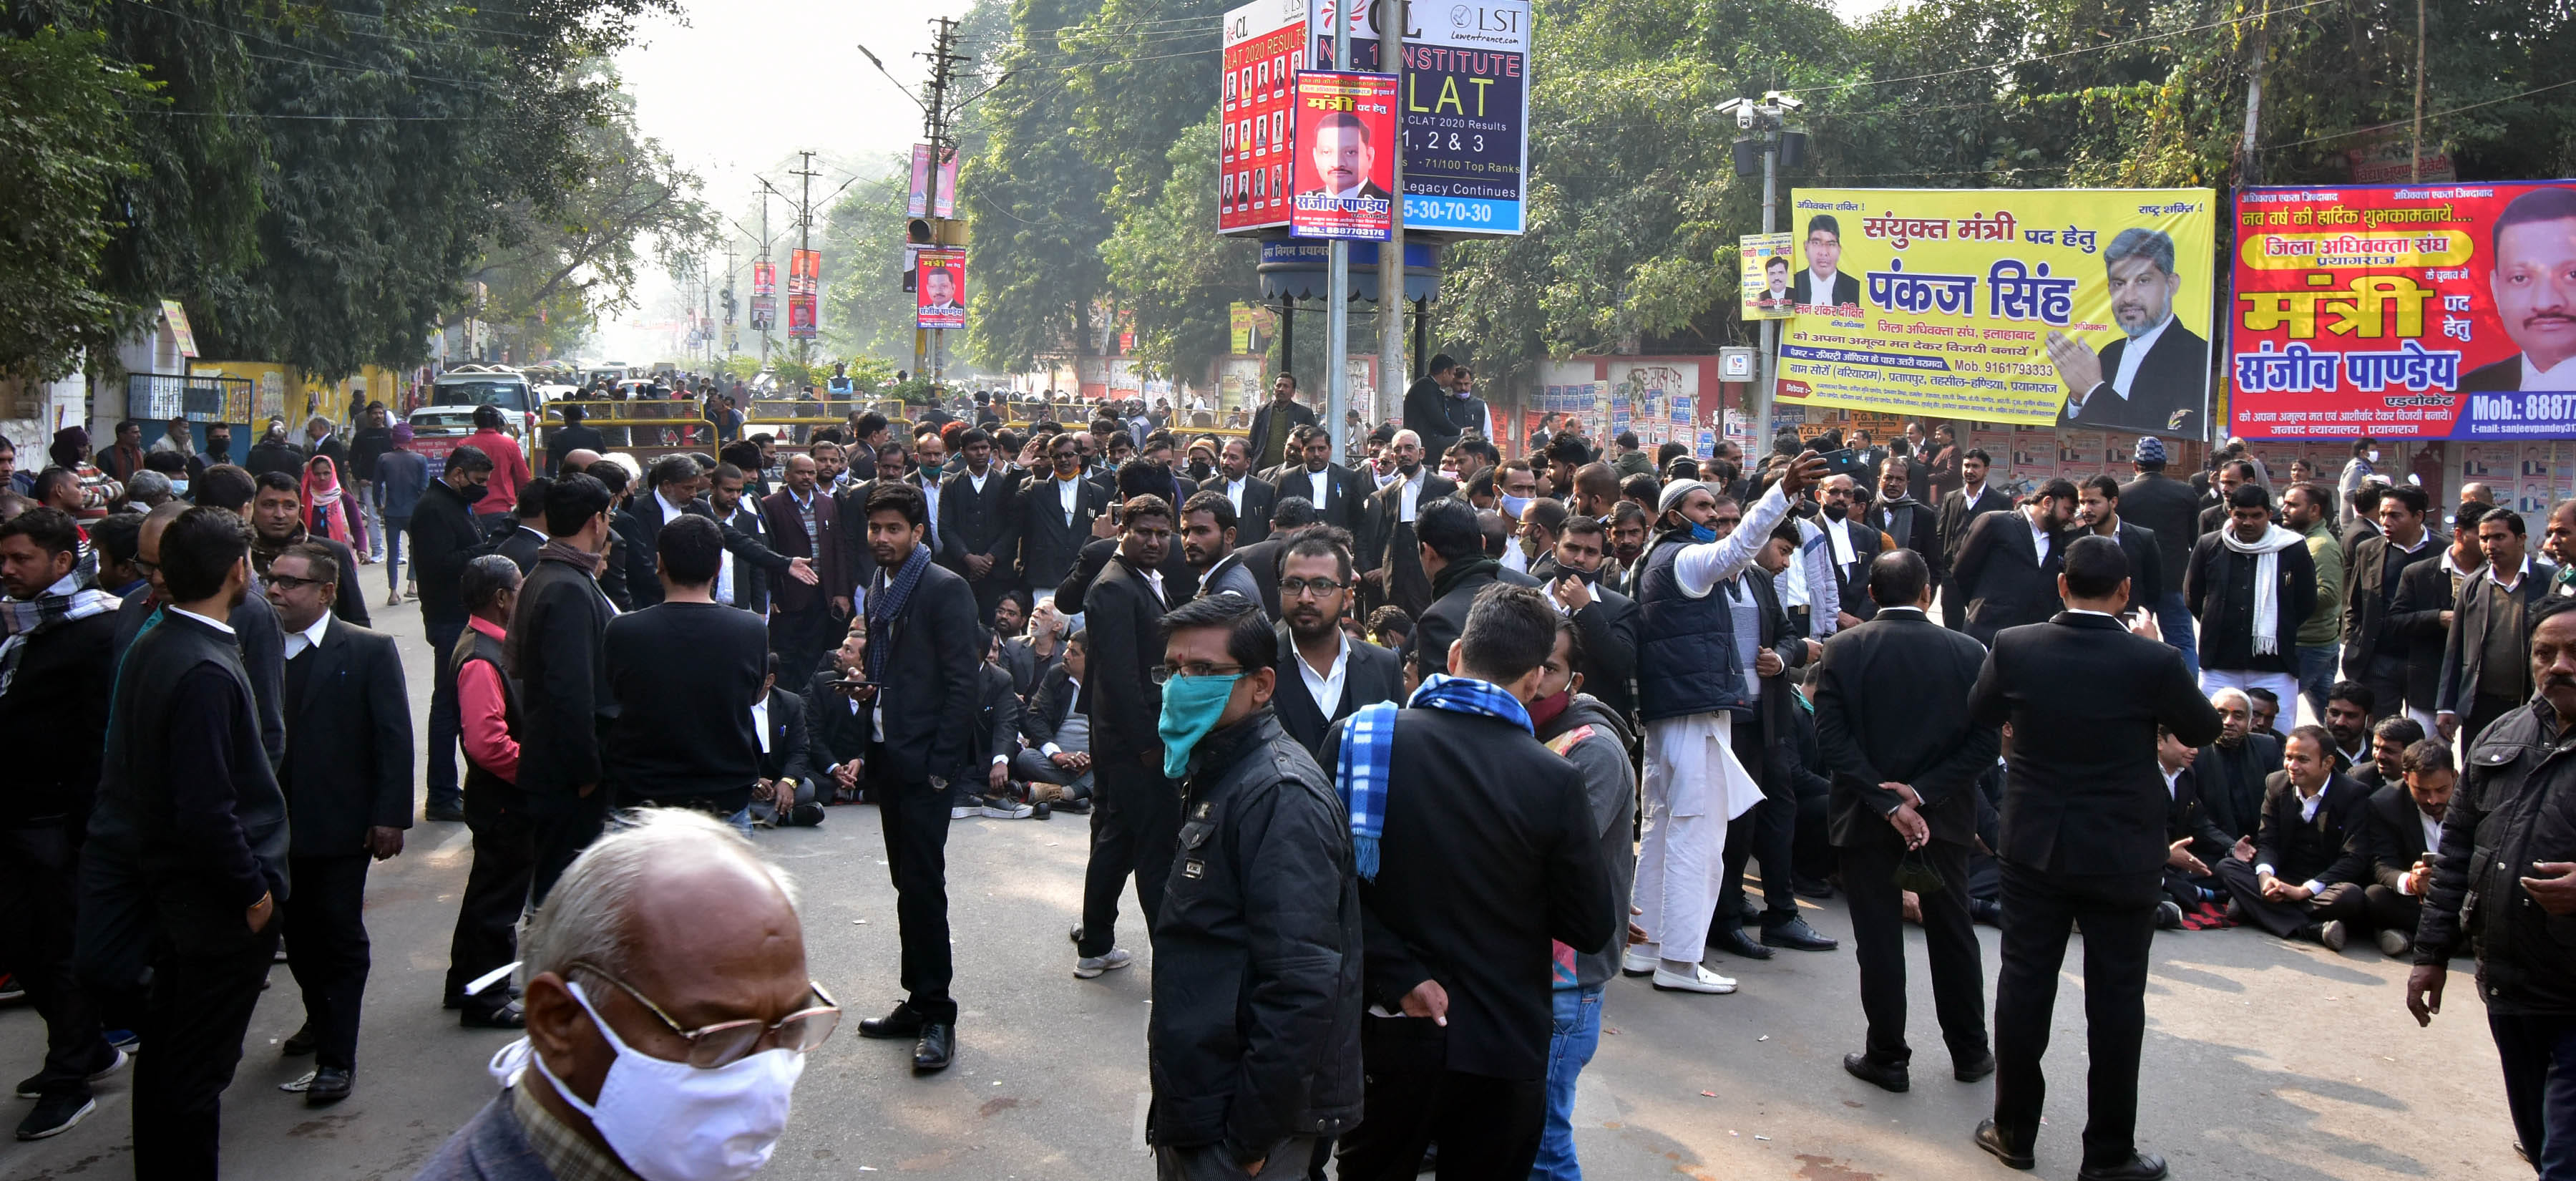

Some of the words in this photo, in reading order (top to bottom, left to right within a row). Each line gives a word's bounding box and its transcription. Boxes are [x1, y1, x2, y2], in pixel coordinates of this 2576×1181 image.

[1236, 16, 1248, 39] CL
[1479, 8, 1522, 33] LST
[1451, 31, 1518, 44] Lawentrance.com
[1224, 49, 1243, 71] CLAT
[1245, 42, 1264, 64] 2020
[1267, 26, 1307, 56] RESULTS
[1319, 38, 1359, 64] N.
[1370, 43, 1378, 65] 1
[1402, 46, 1520, 77] NSTITUTE
[1409, 72, 1494, 117] LAT
[1307, 94, 1356, 112] मंत्री
[1372, 103, 1387, 114] हेतु
[1408, 115, 1435, 126] CLAT
[1440, 117, 1465, 128] 2020
[1468, 120, 1506, 131] Results
[1428, 132, 1439, 150] 2
[1448, 132, 1461, 151] &
[1473, 135, 1483, 152] 3
[1425, 159, 1460, 170] 71/100
[1465, 161, 1484, 172] Top
[1488, 162, 1521, 174] Ranks
[1402, 180, 1448, 196] Legacy
[1453, 183, 1520, 198] Continues.
[2242, 193, 2276, 203] अधिवक्ता
[2279, 194, 2299, 203] एकता
[2302, 192, 2338, 202] जिन्दाबाद
[2394, 189, 2429, 200] अधिवक्ता
[2431, 190, 2454, 198] एकता
[2456, 188, 2494, 198] जिन्दाबाद
[1296, 191, 1339, 212] संजीव
[1342, 195, 1389, 214] पाण्डेय
[1404, 200, 1491, 223] 5-30-70-30
[1796, 200, 1833, 210] अधिवक्ता
[1835, 200, 1858, 210] शक्ति
[2163, 202, 2194, 214] शक्ति
[2242, 212, 2265, 226] नव
[2268, 206, 2290, 225] वर्ष
[2293, 206, 2313, 225] की
[2317, 204, 2360, 226] हार्दिक
[1863, 210, 1951, 250] संयुक्त
[1958, 210, 2016, 242] मंत्री
[2024, 229, 2056, 245] पद
[2062, 225, 2097, 254] हेतु
[1275, 244, 1296, 256] निगम
[1299, 246, 1330, 256] प्रयागर
[2265, 235, 2316, 256] जिला
[2321, 234, 2411, 255] अधिवक्ता
[2414, 232, 2450, 254] संघ
[2316, 256, 2396, 267] प्रयागराज
[2426, 268, 2434, 280] के
[2436, 270, 2458, 283] चुनाव
[2460, 268, 2469, 280] में
[1865, 257, 1978, 318] पंकज
[1987, 258, 2078, 327] सिंह
[1814, 301, 1837, 316] शंकर
[1838, 301, 1865, 319] दीक्षित
[2238, 273, 2436, 339] मंत्री
[2444, 294, 2472, 312] पद
[1878, 319, 1903, 334] जिला
[1906, 321, 1953, 337] अधिवक्ता
[1983, 329, 2036, 341] इलाहाबाद
[2073, 321, 2107, 332] अधिवक्ता
[2443, 315, 2472, 341] हेतु
[1793, 331, 1807, 341] को
[1811, 334, 1845, 344] अपना
[1849, 336, 1886, 349] अमूल्य
[1890, 340, 1913, 349] मत
[1915, 341, 1943, 351] देकर
[1946, 341, 1986, 354] विजयी
[1871, 354, 1878, 363] के
[1880, 356, 1896, 365] पास
[1955, 359, 1981, 372] Mob.
[1985, 361, 2053, 376] 9161793333
[2235, 340, 2341, 393] संजीव
[2344, 339, 2462, 393] पाण्डेय
[2011, 381, 2057, 394] प्रयागराज
[2384, 393, 2455, 407] एडवोकेट
[2473, 396, 2522, 420] Mob.:
[2239, 410, 2250, 422] को
[2253, 412, 2277, 422] अपना
[2279, 412, 2307, 424] अमूल्य
[2308, 412, 2323, 422] मत
[2326, 410, 2338, 421] एवं
[2339, 409, 2373, 421] आशीर्वाद
[2376, 409, 2394, 421] देकर
[2396, 409, 2422, 421] विजयी
[2270, 425, 2306, 434] जनपद
[2368, 425, 2419, 434] प्रयागराज
[2472, 424, 2500, 433] E-mail:
[2502, 424, 2576, 434] sanjeevpandey31
